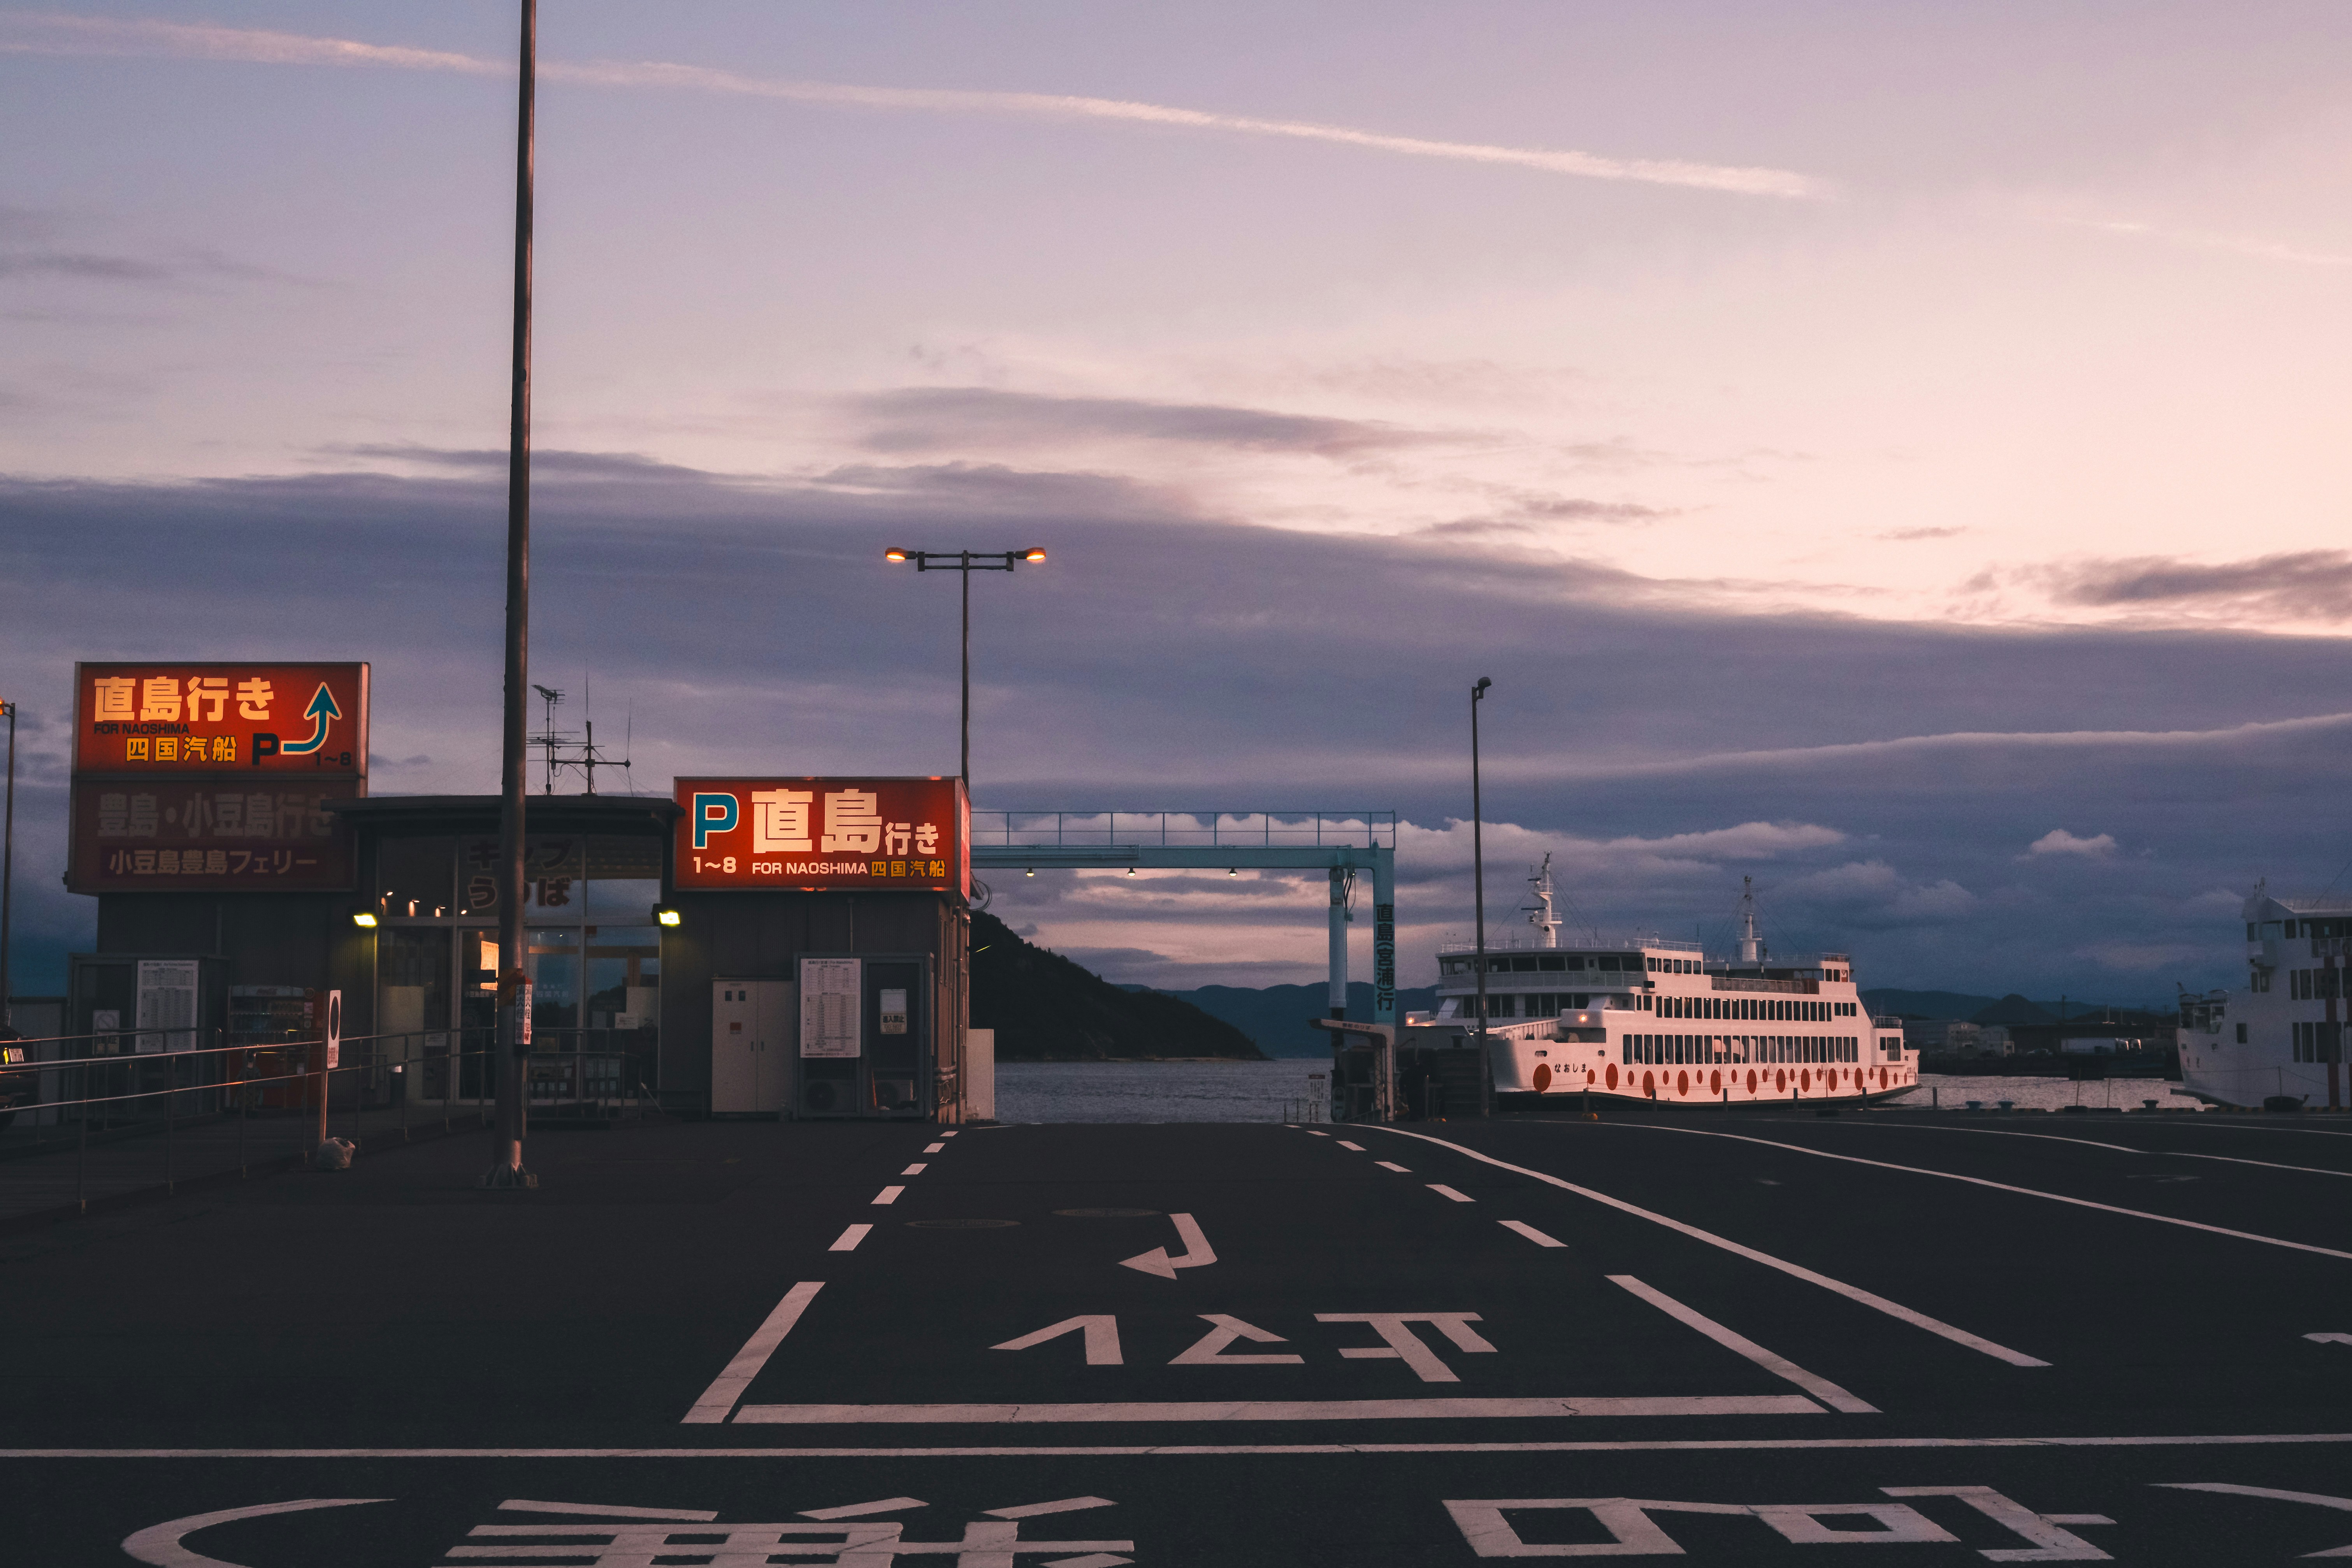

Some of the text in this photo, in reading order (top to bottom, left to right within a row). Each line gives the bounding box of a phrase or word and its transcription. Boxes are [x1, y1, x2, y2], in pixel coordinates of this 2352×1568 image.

[94, 676, 274, 722] 直島行き
[94, 723, 190, 734] FOR NAOSHIMA
[125, 736, 237, 762] 四国汽船
[252, 733, 279, 765] P
[692, 792, 740, 850] P
[752, 788, 939, 855] 直島行き
[109, 849, 318, 875] 小豆島豊島フェリー
[469, 839, 573, 871] キプ
[752, 862, 868, 874] FOR NAOSHIMA
[870, 860, 946, 878] 四国汽船
[1376, 903, 1395, 1011] 直島(宮浦)行
[1554, 1063, 1587, 1073] なおしま
